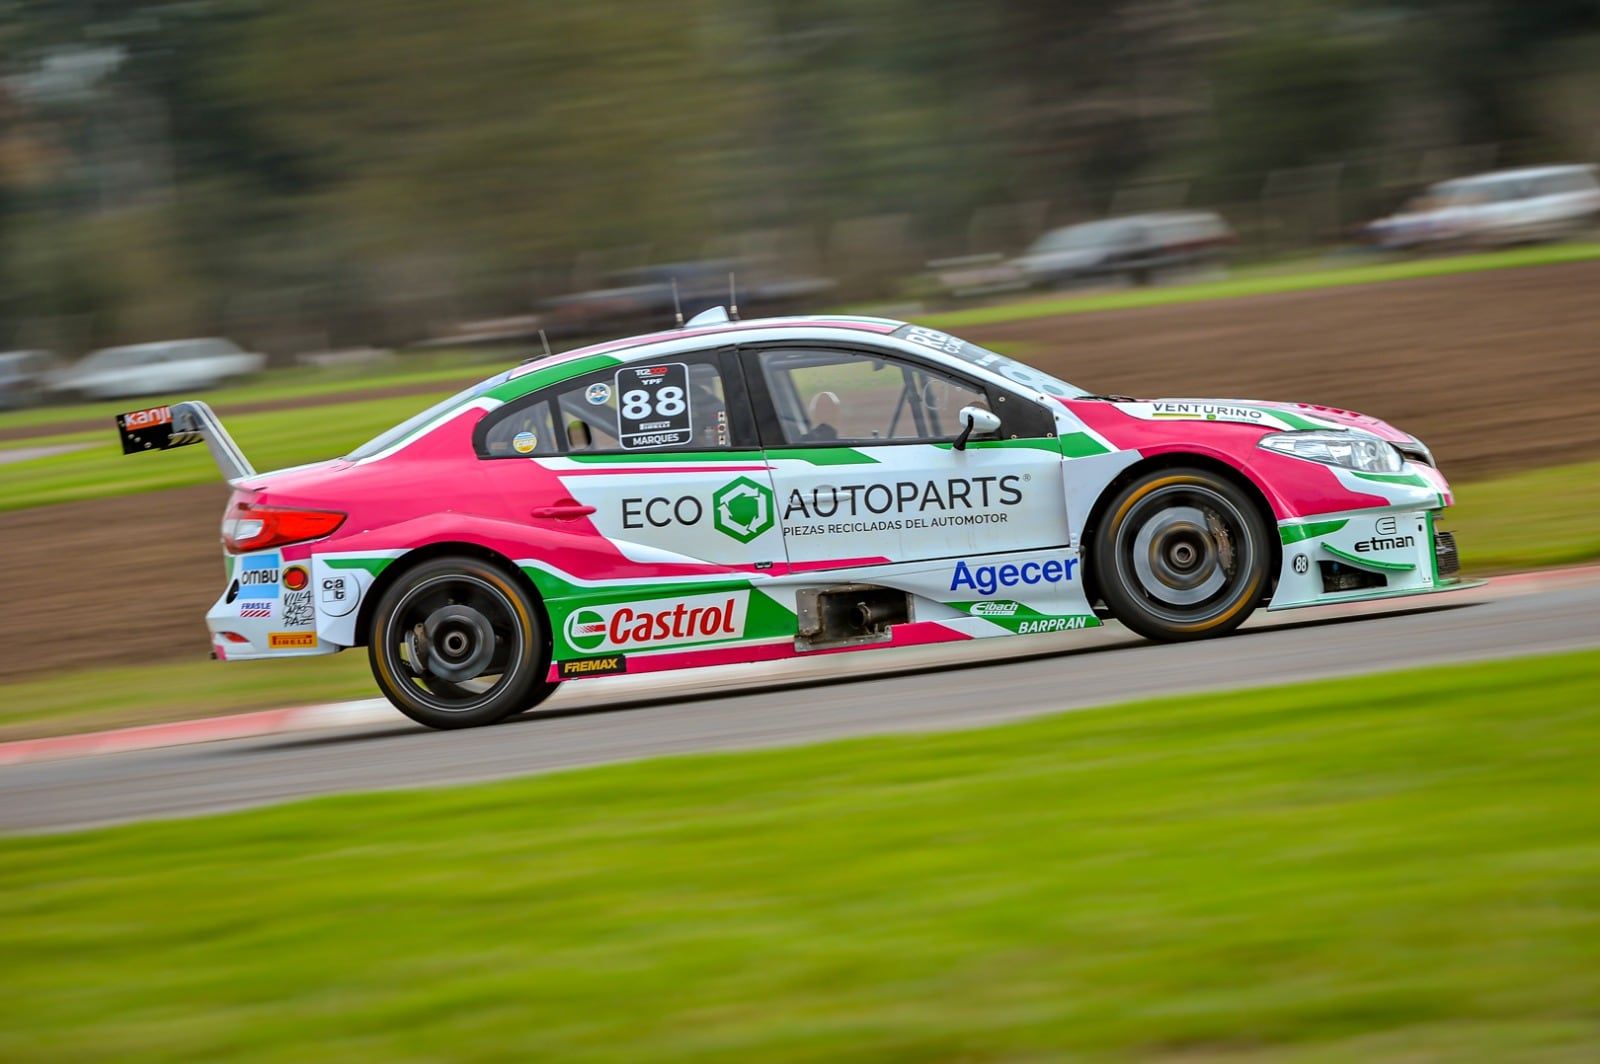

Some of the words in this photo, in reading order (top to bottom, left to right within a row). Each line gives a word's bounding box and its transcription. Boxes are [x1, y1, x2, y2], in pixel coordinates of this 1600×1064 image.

[641, 378, 663, 386] YPF
[622, 386, 686, 420] 88
[1153, 403, 1262, 419] VENTURINO
[124, 406, 171, 425] kanji
[632, 433, 680, 446] MARQUES
[622, 495, 703, 529] ECO
[783, 525, 825, 537] PIEZAS
[827, 520, 902, 534] RECICLADAS
[906, 518, 928, 529] DEL
[931, 513, 1008, 528] AUTOMOTOR
[1295, 556, 1307, 573] 88
[950, 557, 1078, 596] Agecer
[969, 601, 1019, 615] Eibach
[609, 598, 735, 645] Castrol
[1018, 616, 1087, 634] BARPRAN
[271, 634, 313, 646] PIRELLI
[564, 657, 619, 673] FREMAX
